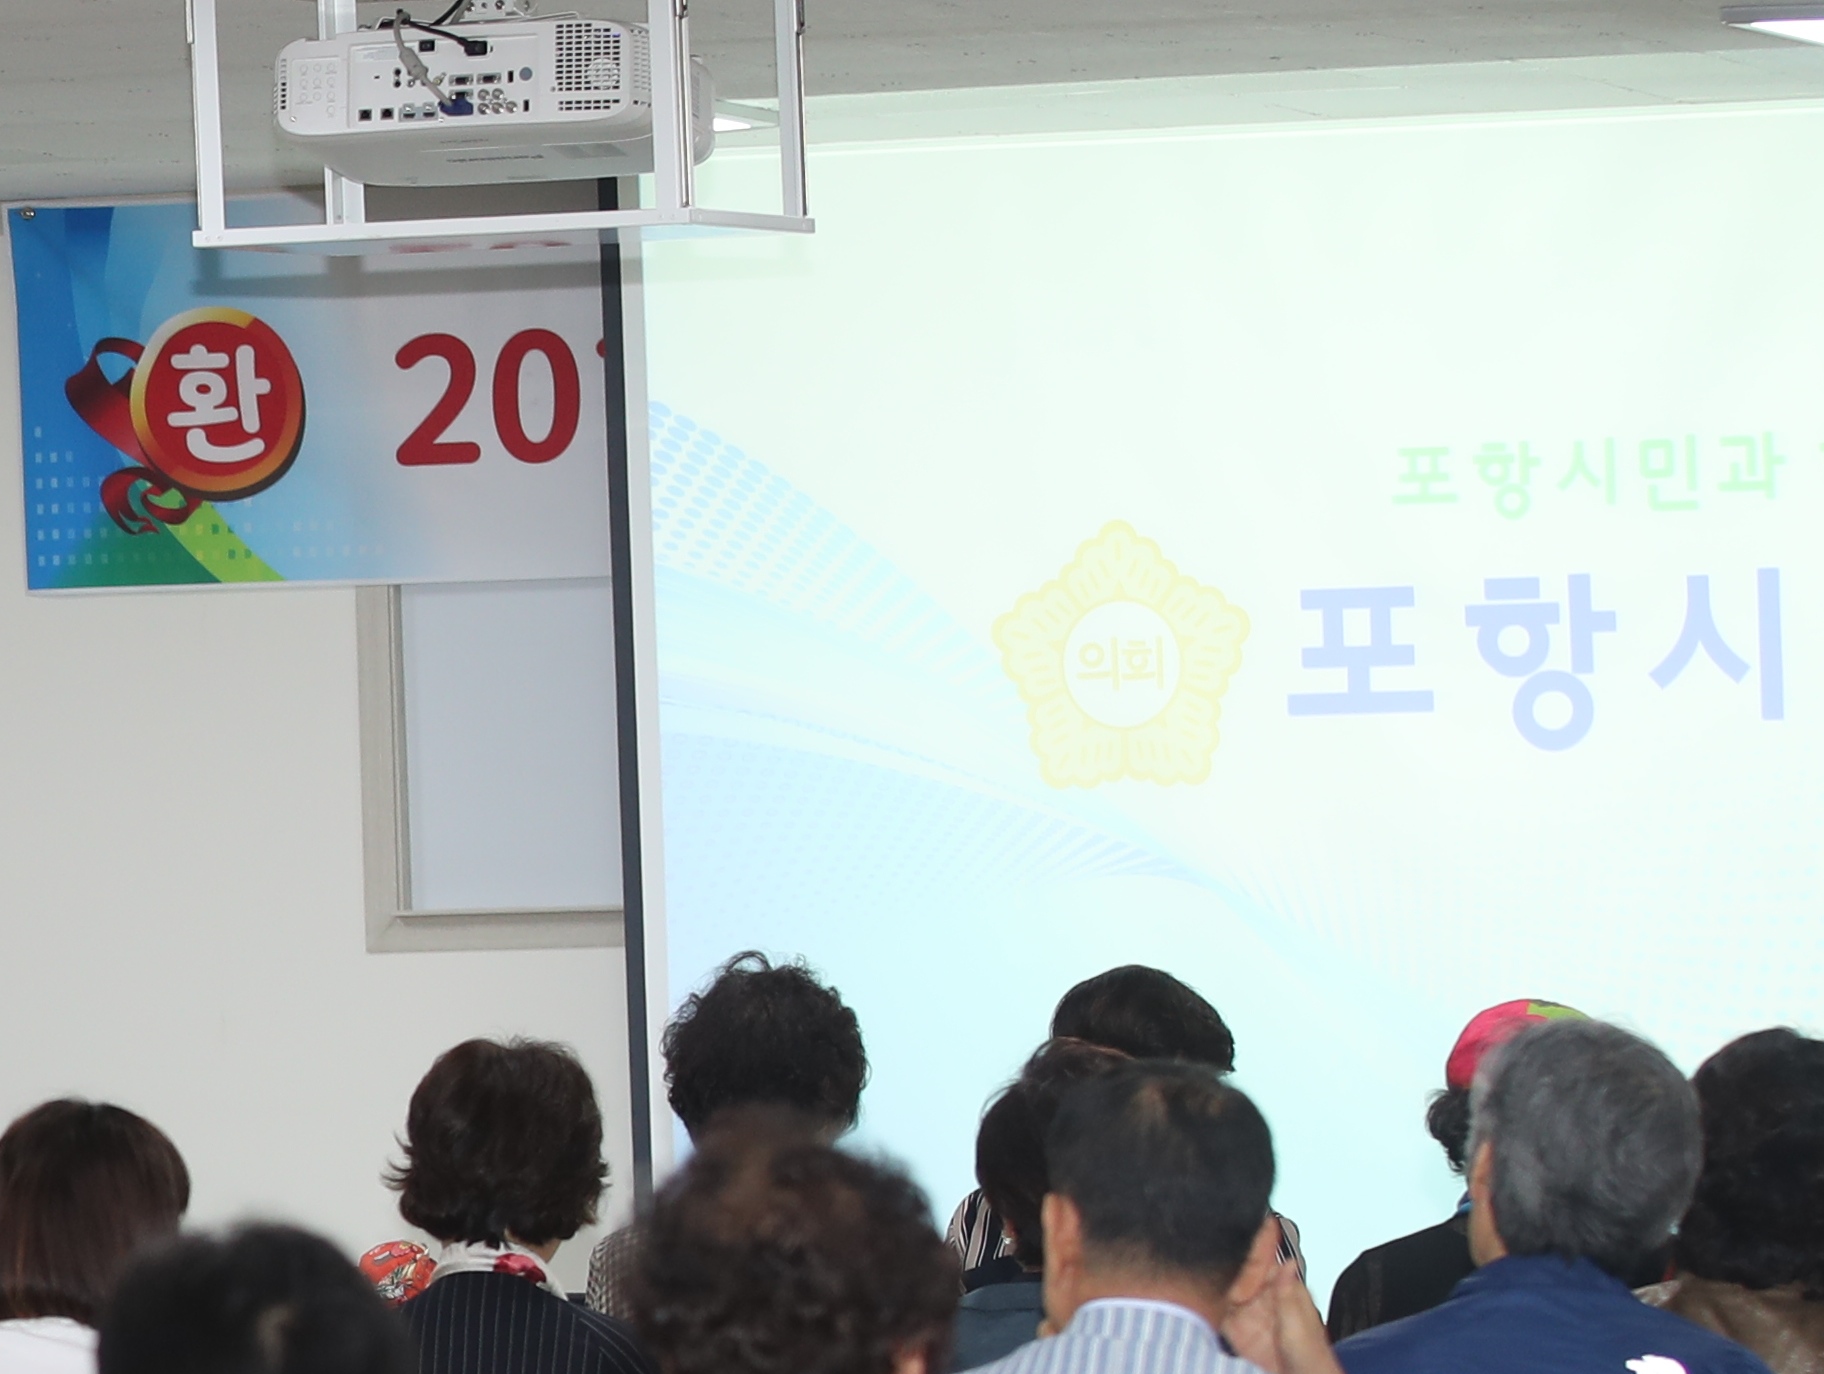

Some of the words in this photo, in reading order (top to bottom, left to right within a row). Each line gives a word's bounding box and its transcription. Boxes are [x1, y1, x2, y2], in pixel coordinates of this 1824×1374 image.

[167, 344, 271, 463] 환
[395, 328, 606, 467] 20
[1392, 431, 1785, 520] 포항시민과
[1076, 635, 1164, 692] 의회
[1287, 566, 1786, 753] 포항시
